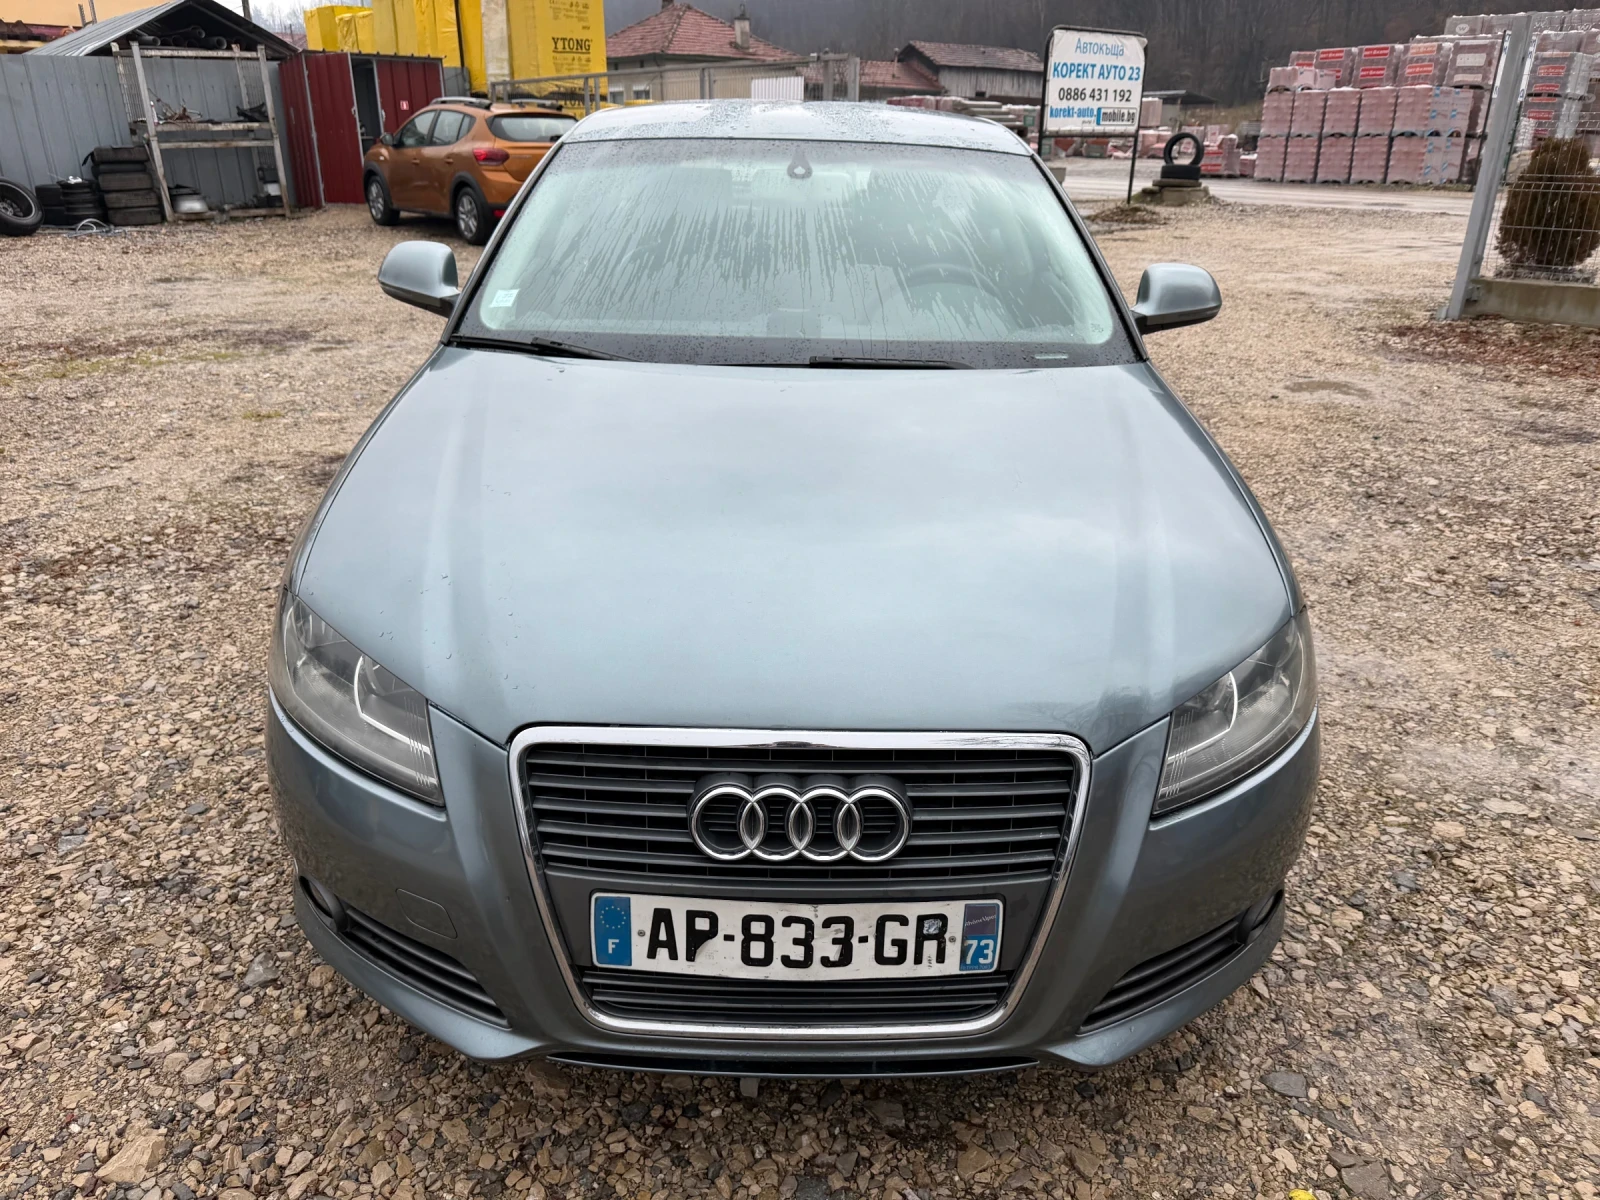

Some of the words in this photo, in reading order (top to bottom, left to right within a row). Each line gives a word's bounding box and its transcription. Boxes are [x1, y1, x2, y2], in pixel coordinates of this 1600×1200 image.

[552, 36, 591, 51] YTONG
[1075, 38, 1124, 58] Автокъща
[1053, 62, 1097, 79] КОРЕКТ
[1098, 64, 1126, 80] АУТО
[1128, 66, 1141, 81] 23
[1058, 87, 1087, 101] 0886
[1089, 88, 1109, 102] 431
[1113, 89, 1132, 102] 192
[608, 939, 619, 953] F
[647, 907, 948, 968] AP-833-GR
[963, 939, 994, 965] 73
